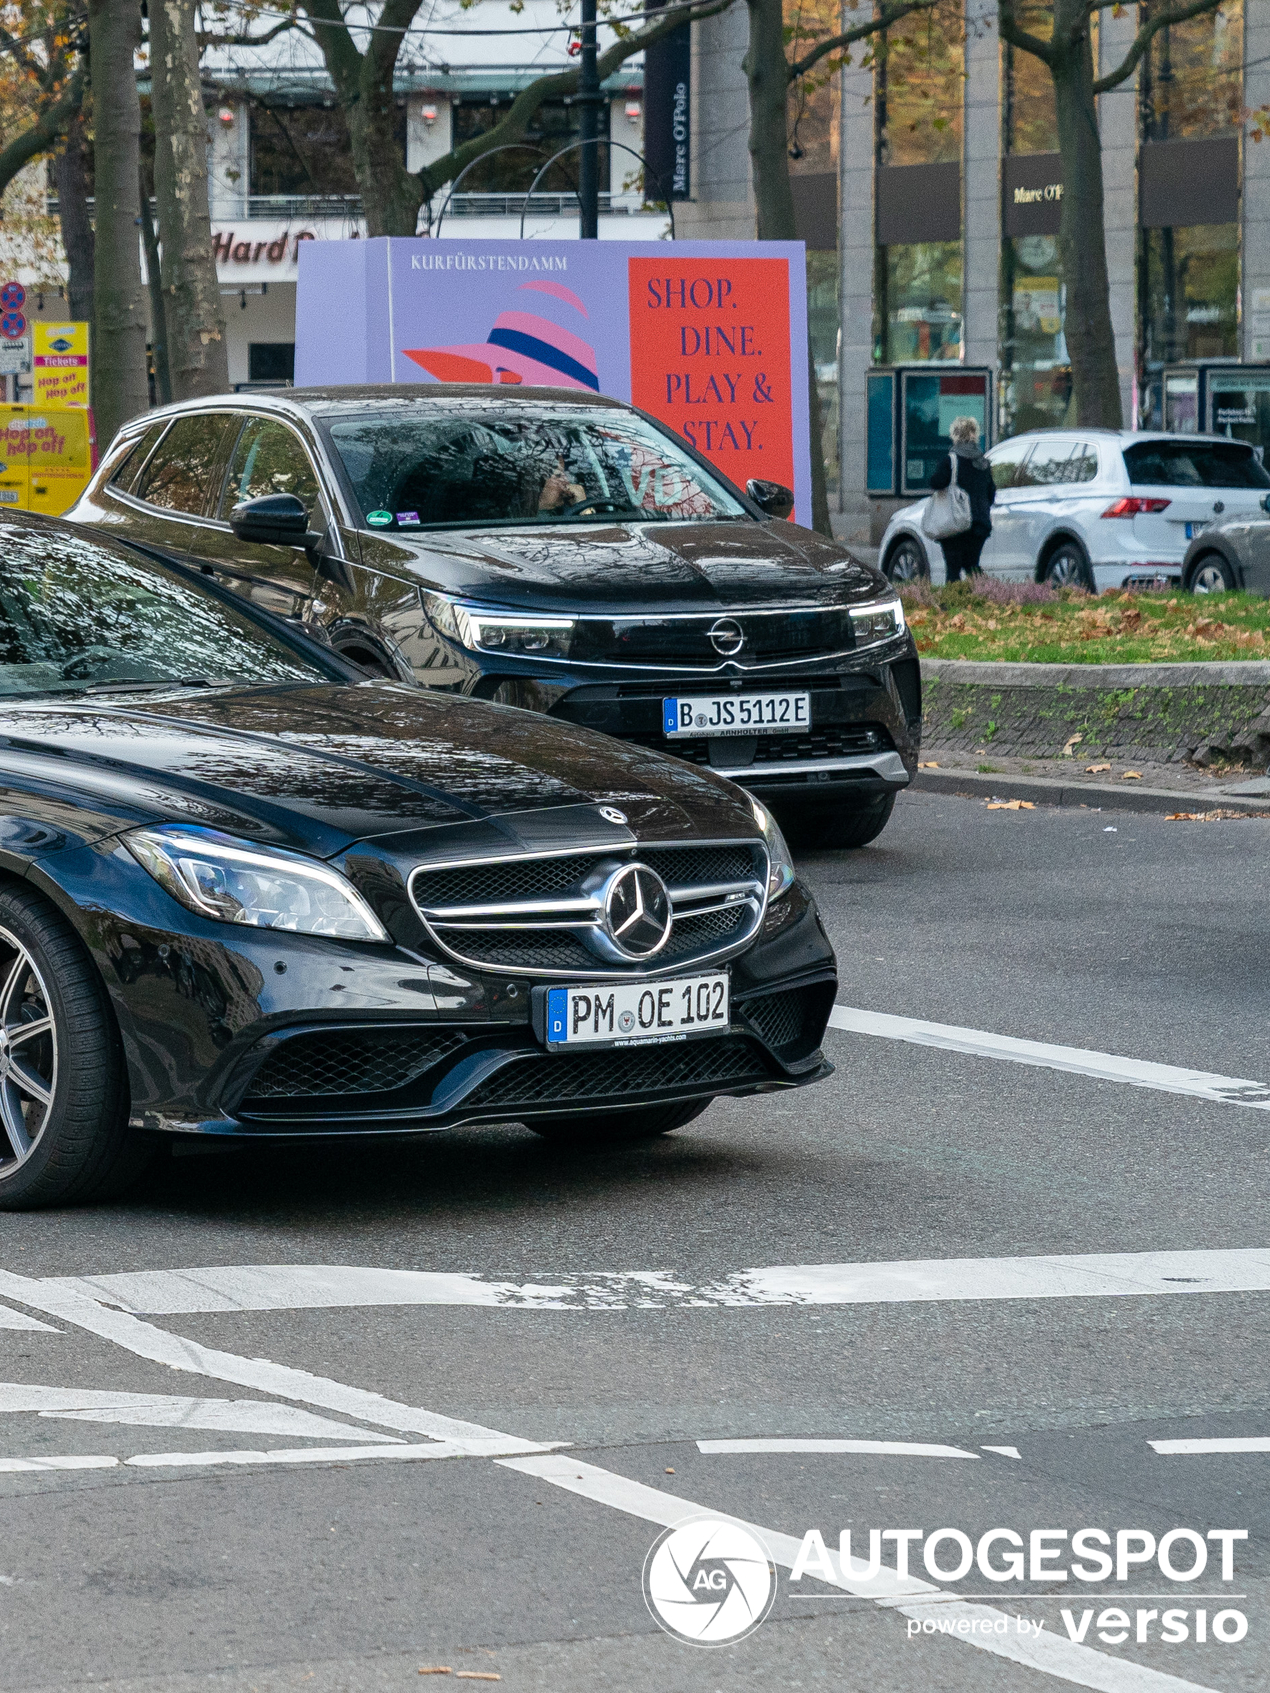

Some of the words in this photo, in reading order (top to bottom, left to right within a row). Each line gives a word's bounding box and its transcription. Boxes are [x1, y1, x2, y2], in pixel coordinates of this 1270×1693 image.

[672, 82, 687, 141] O'Polo
[672, 143, 686, 192] Marc
[1014, 186, 1043, 203] Marc
[212, 231, 288, 264] Hard
[411, 252, 567, 271] KURFÜRSTENDAMM
[647, 278, 737, 309] SHOP.
[680, 326, 763, 356] DINE.
[43, 356, 79, 367] Tickets
[666, 373, 743, 404] PLAY
[752, 372, 774, 404] &
[682, 420, 764, 450] STAY.
[679, 703, 693, 727] B
[708, 700, 735, 726] JS
[719, 728, 768, 737] ARNHOLTER
[772, 727, 789, 735] GmbH
[571, 993, 615, 1035] PM
[637, 987, 674, 1029] OE
[680, 980, 725, 1025] 102
[614, 1034, 687, 1047] www.aquamarin-yachts.com
